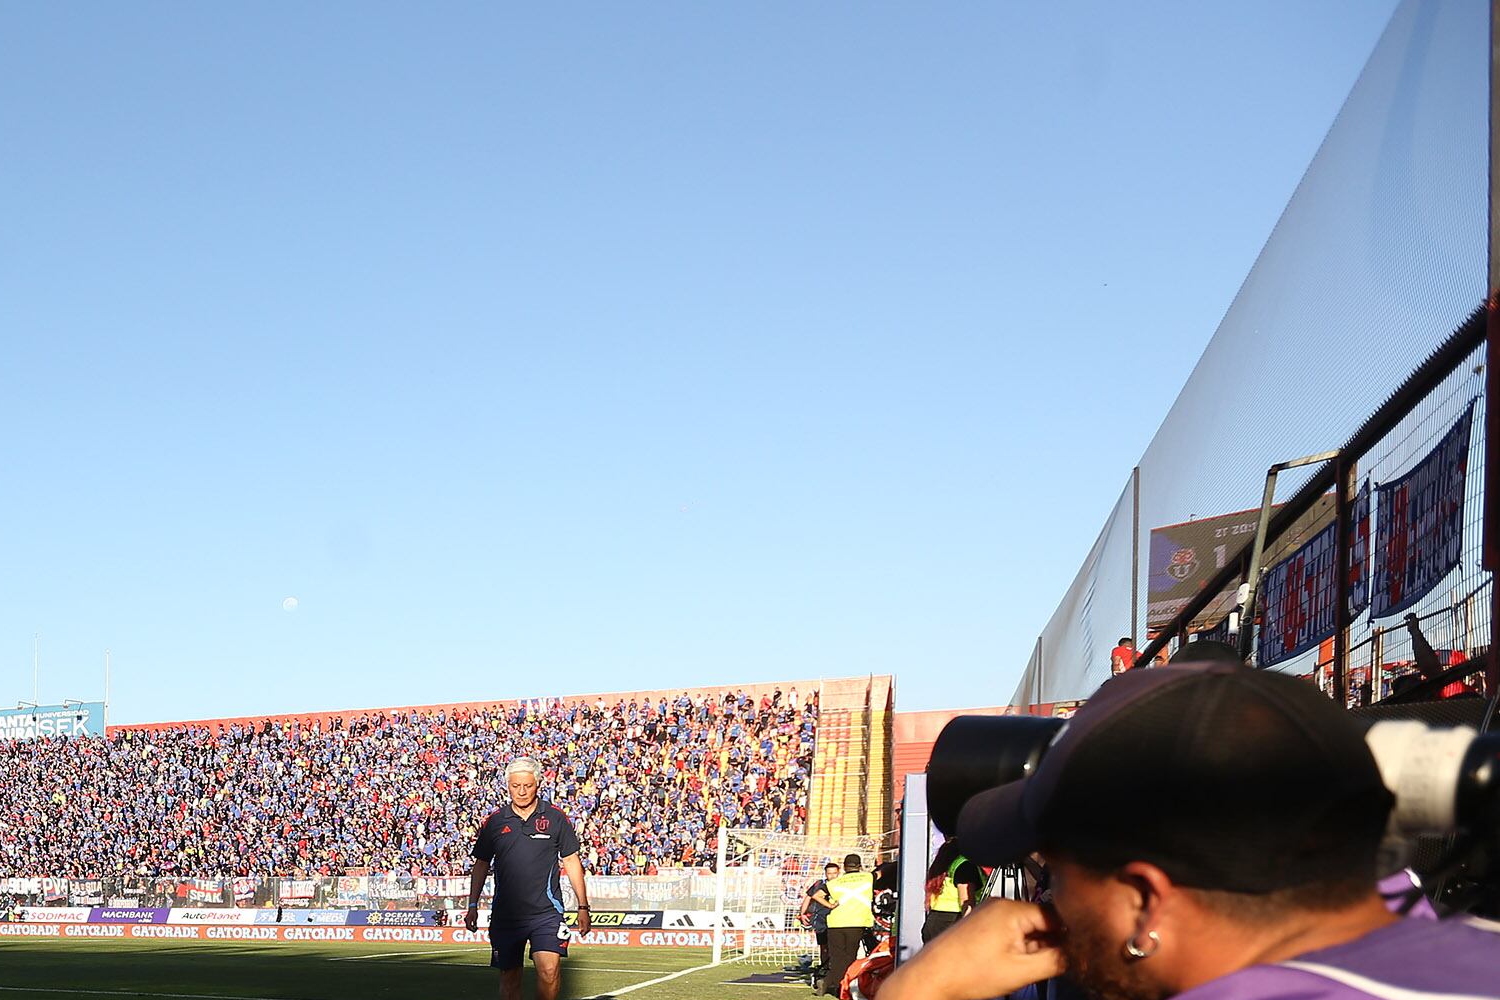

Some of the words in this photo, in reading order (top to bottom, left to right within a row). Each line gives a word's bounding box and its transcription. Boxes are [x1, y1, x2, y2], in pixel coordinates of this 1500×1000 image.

[40, 709, 89, 718] UNIVERSIDAD
[40, 717, 89, 737] SEK
[30, 911, 84, 921] SODIMAC
[101, 911, 154, 920] MACHBANK
[181, 911, 242, 921] AutoPlanet
[621, 914, 655, 924] BET
[0, 925, 59, 935] GATORADE
[65, 926, 124, 936] GATORADE
[131, 926, 198, 938] GATORADE
[206, 927, 277, 939] GATORADE
[284, 928, 354, 939] GATORADE
[363, 928, 443, 941] GATORADE
